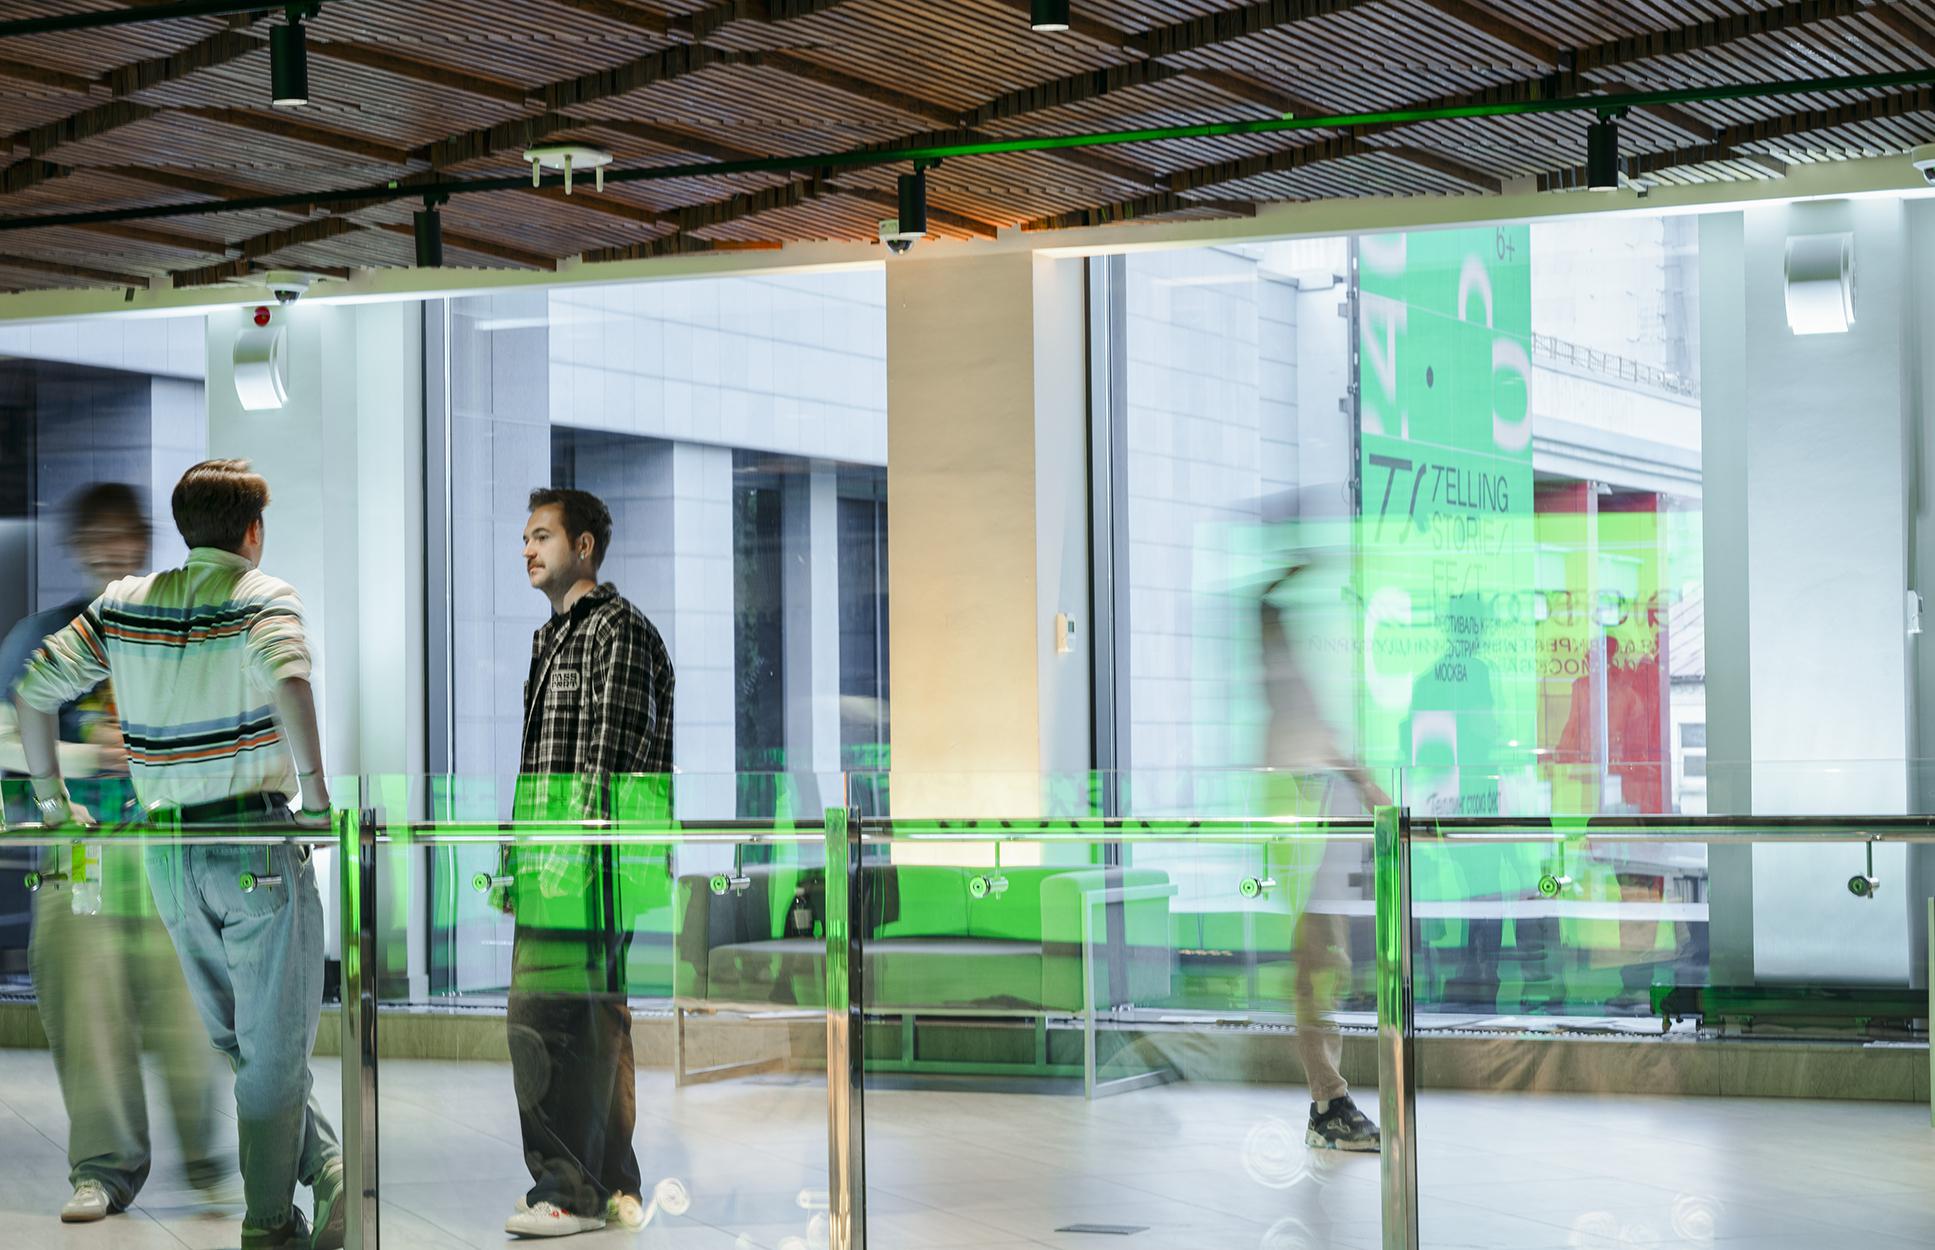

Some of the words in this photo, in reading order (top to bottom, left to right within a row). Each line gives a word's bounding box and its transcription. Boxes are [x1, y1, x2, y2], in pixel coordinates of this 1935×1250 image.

[1496, 224, 1515, 263] 6+
[1431, 464, 1509, 513] TELLING
[551, 672, 577, 681] PASS
[1434, 663, 1468, 682] МОСКВА
